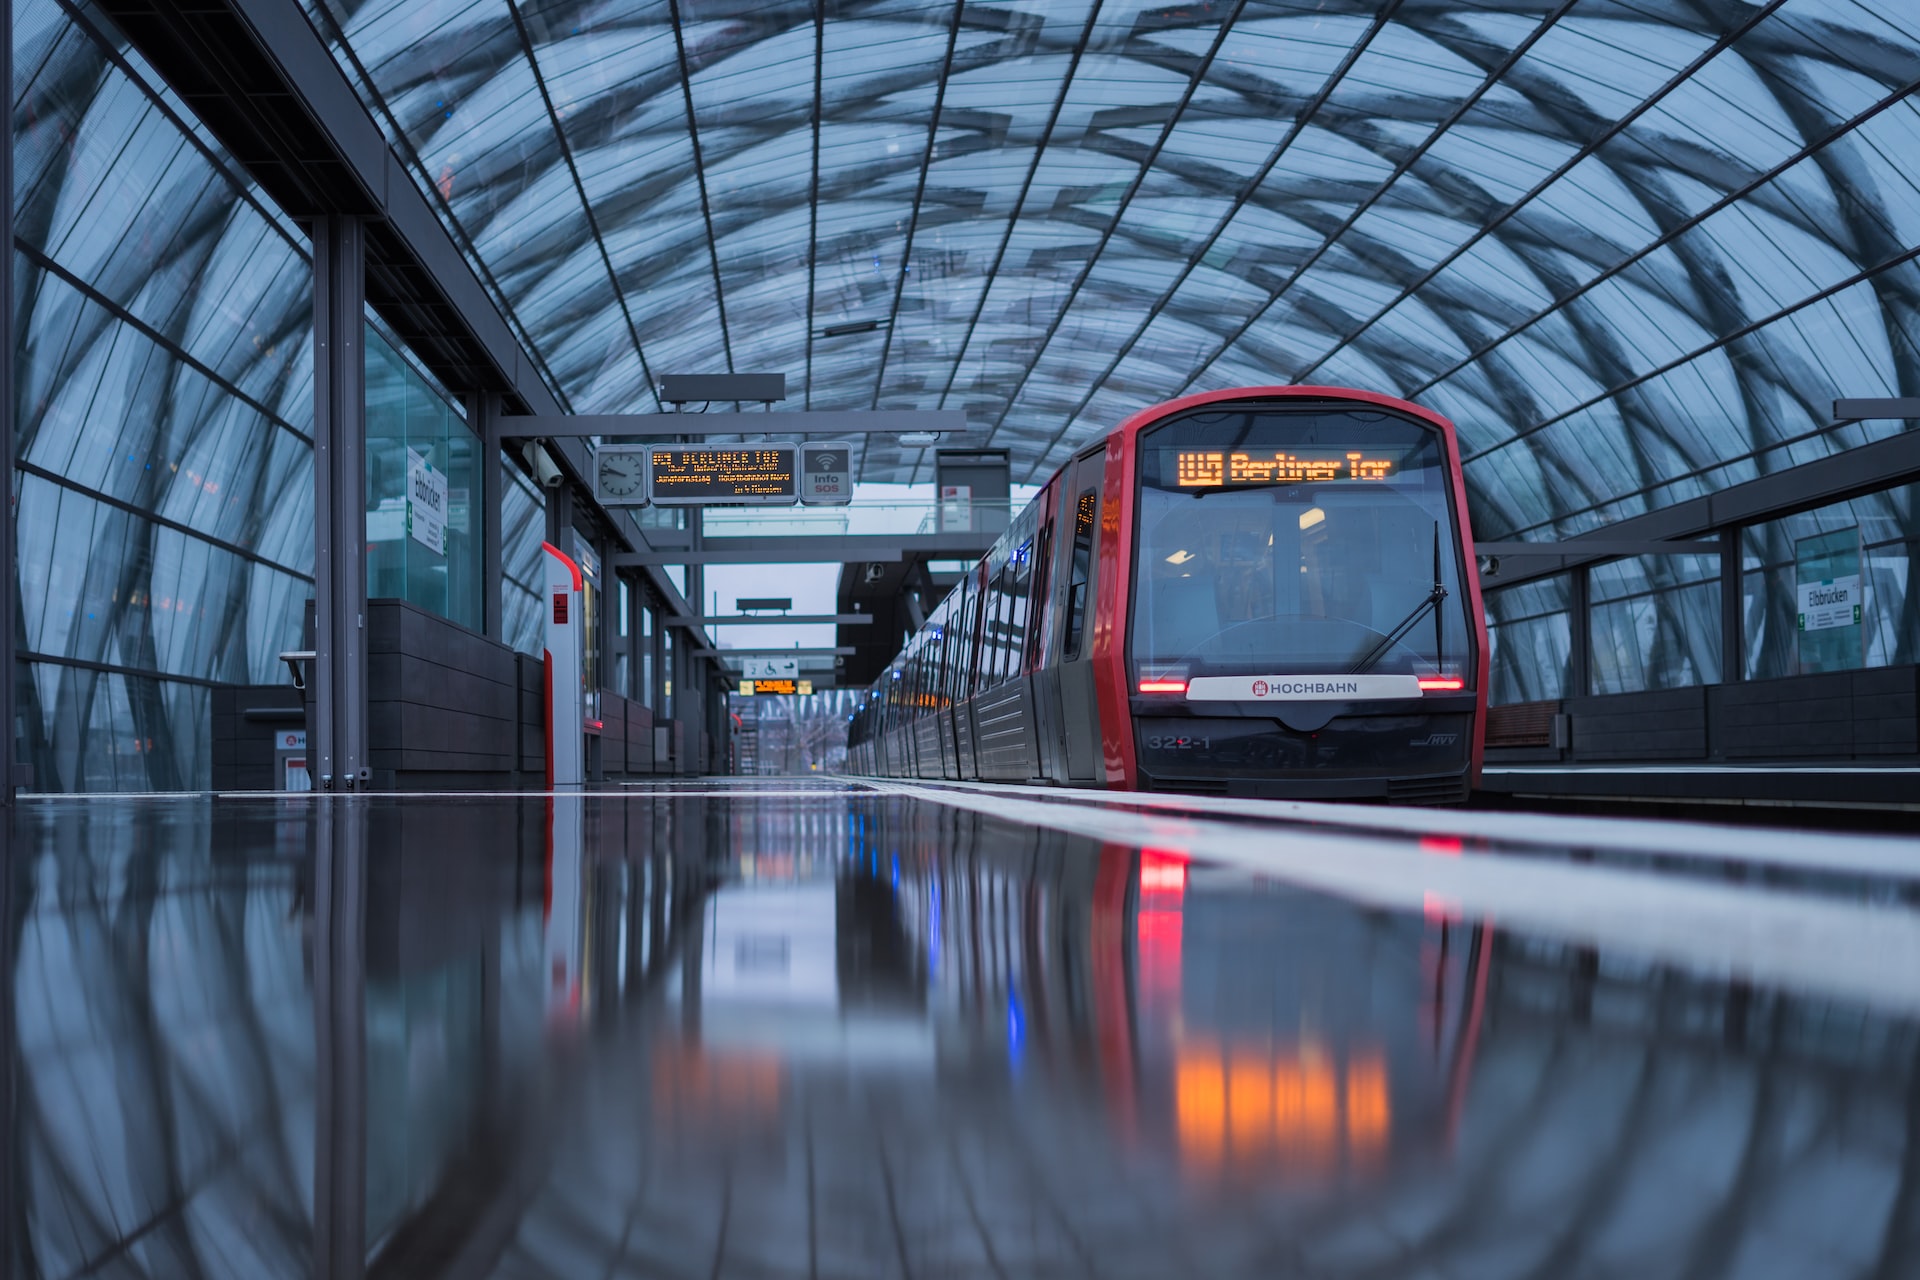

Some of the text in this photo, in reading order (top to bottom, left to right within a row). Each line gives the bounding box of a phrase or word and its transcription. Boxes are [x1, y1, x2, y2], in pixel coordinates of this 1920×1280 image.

[1231, 453, 1342, 481] Berliner
[1346, 453, 1391, 480] Tor
[814, 474, 839, 483] Info
[815, 484, 839, 493] SOS
[1808, 586, 1848, 607] Elbbrücken
[1271, 682, 1358, 694] HOCHBAHN
[1148, 735, 1210, 749] 322-1
